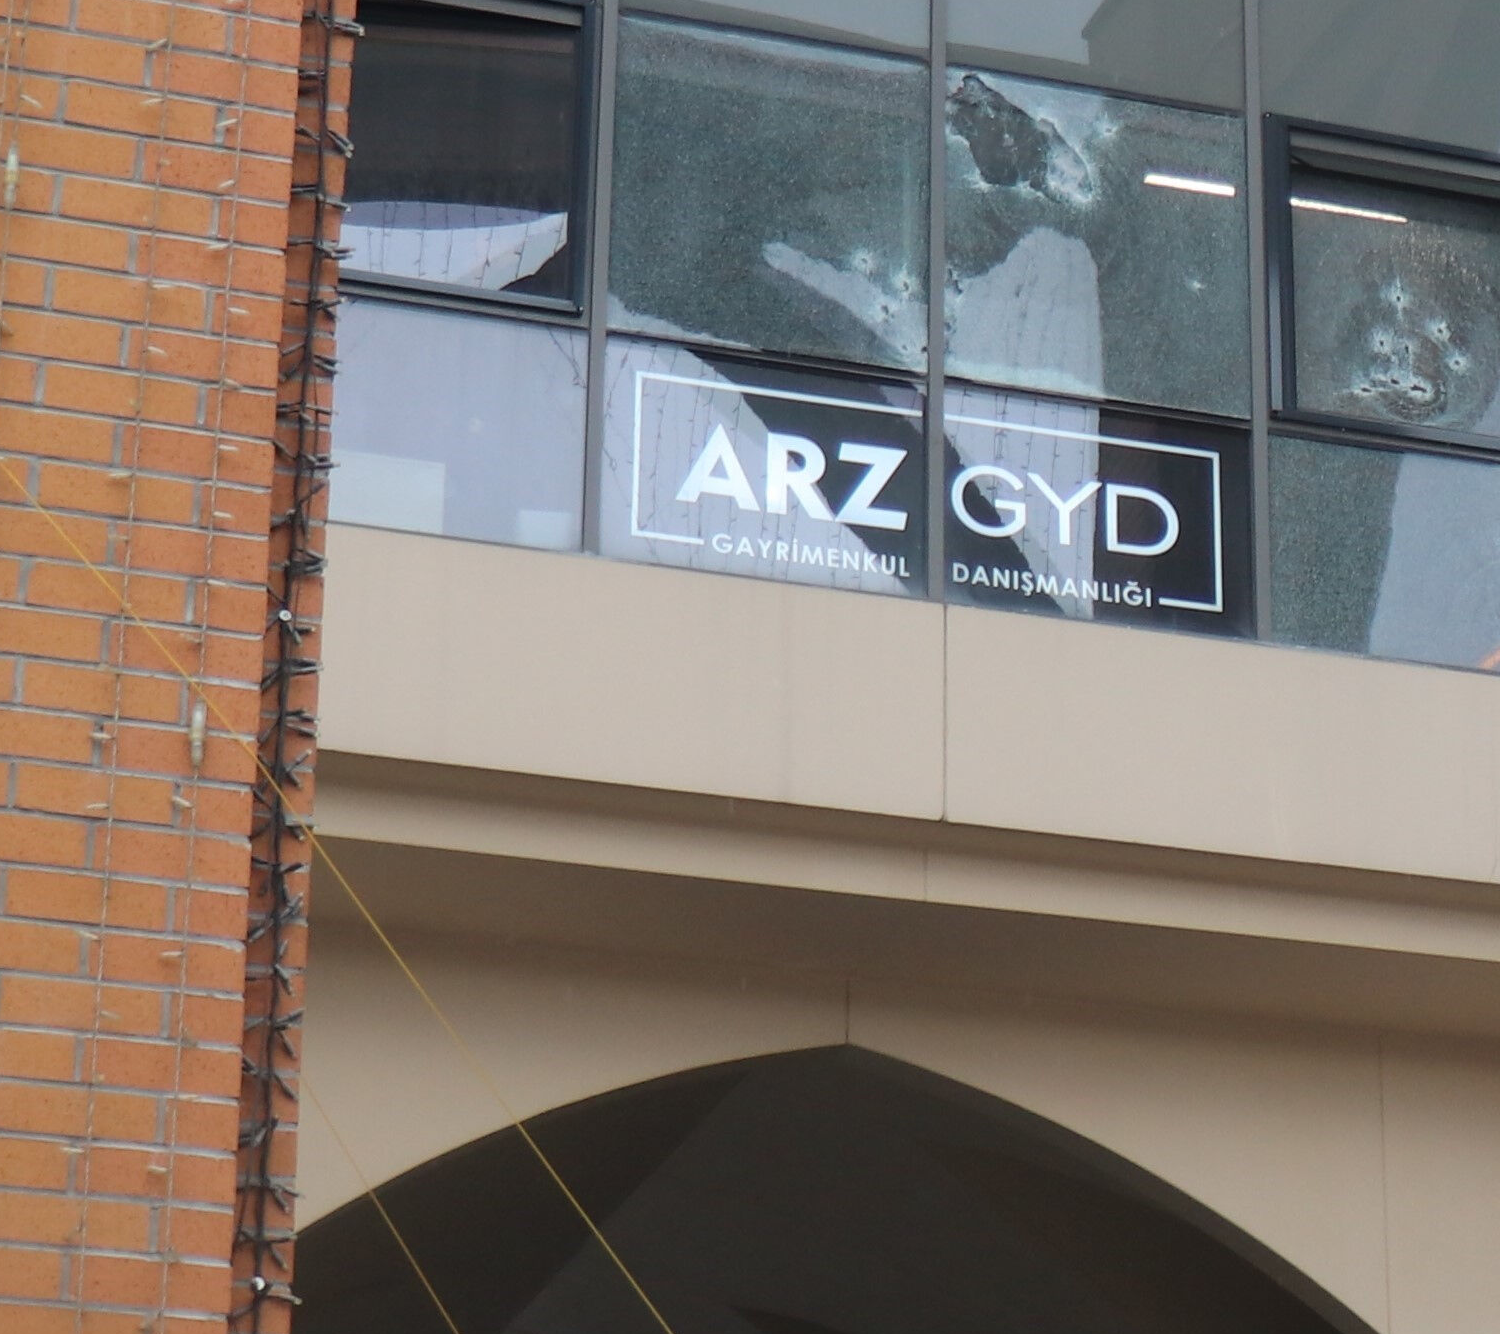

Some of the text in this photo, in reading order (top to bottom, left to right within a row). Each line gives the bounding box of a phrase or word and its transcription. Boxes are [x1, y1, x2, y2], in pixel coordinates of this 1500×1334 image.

[675, 423, 1180, 556] ARZ GYD
[711, 532, 1153, 608] GAYRİMENKUL DANIŞMANLIĞI
